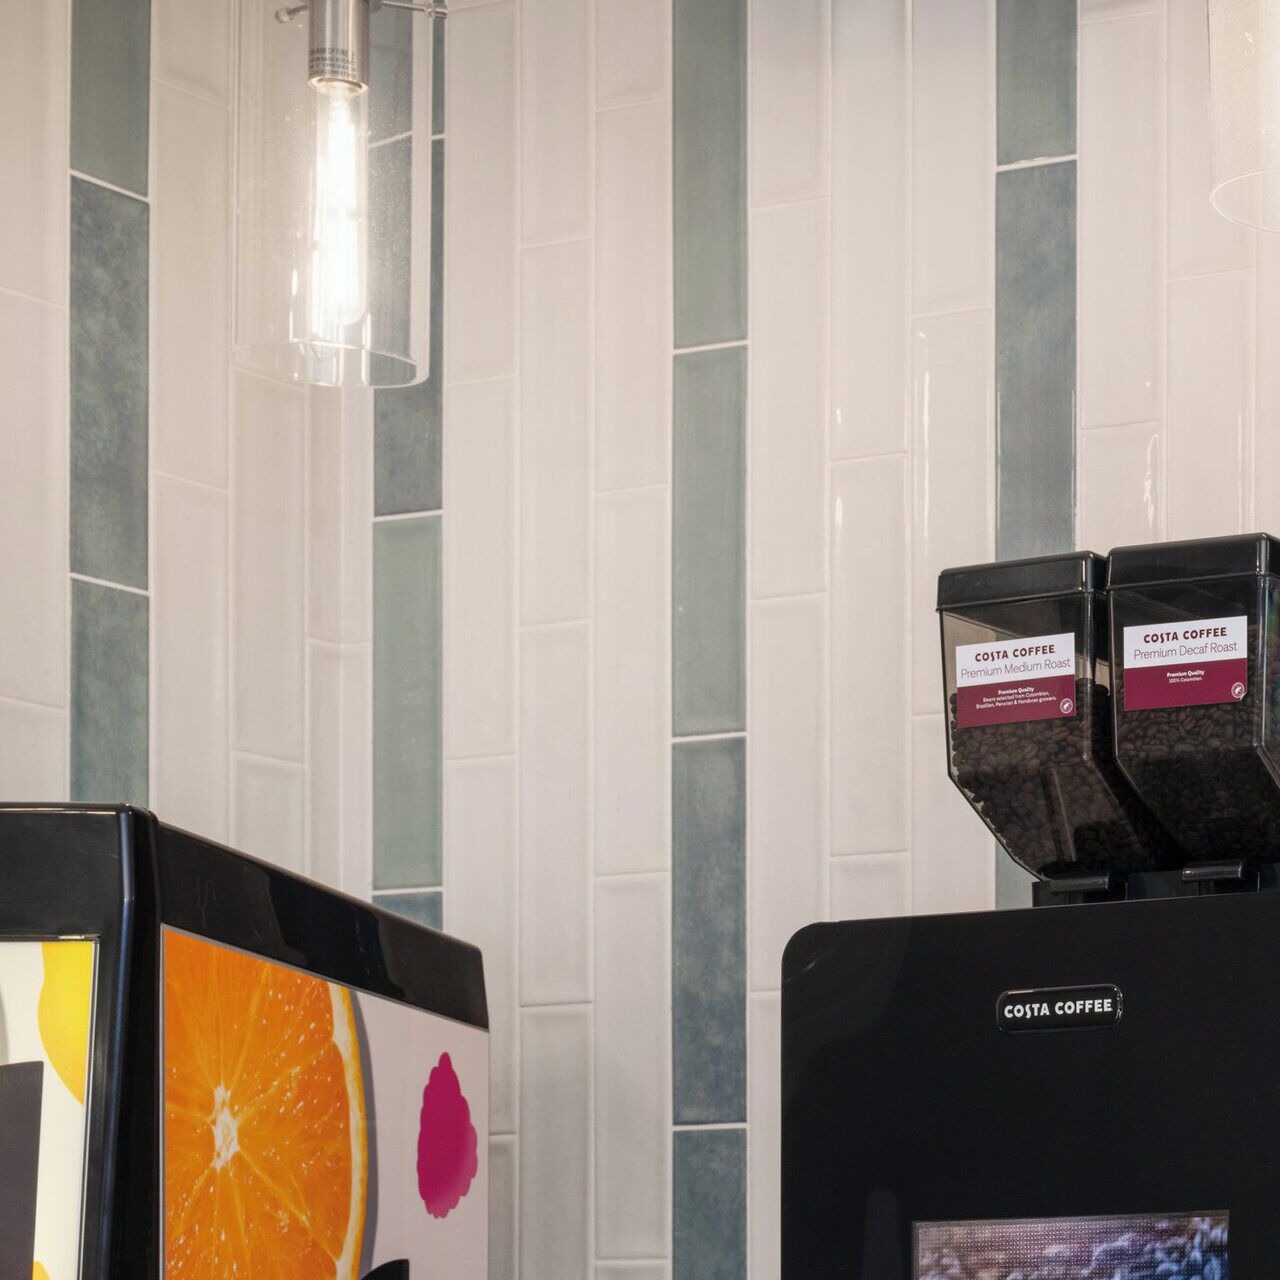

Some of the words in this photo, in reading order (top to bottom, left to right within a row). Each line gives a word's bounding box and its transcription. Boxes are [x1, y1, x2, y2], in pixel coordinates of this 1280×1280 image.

[1144, 632, 1179, 644] COSTA
[1183, 627, 1227, 640] COFFEE
[975, 650, 1009, 662] COSTA
[1012, 644, 1056, 658] COFFEE
[1133, 648, 1177, 660] Premium
[1179, 643, 1209, 656] Decaf
[1210, 642, 1238, 653] Roast
[960, 668, 1002, 679] Premium
[1004, 662, 1042, 674] Medium
[1044, 658, 1072, 670] Roast
[1003, 1003, 1050, 1019] COSTA
[1054, 999, 1113, 1015] COFFEE
